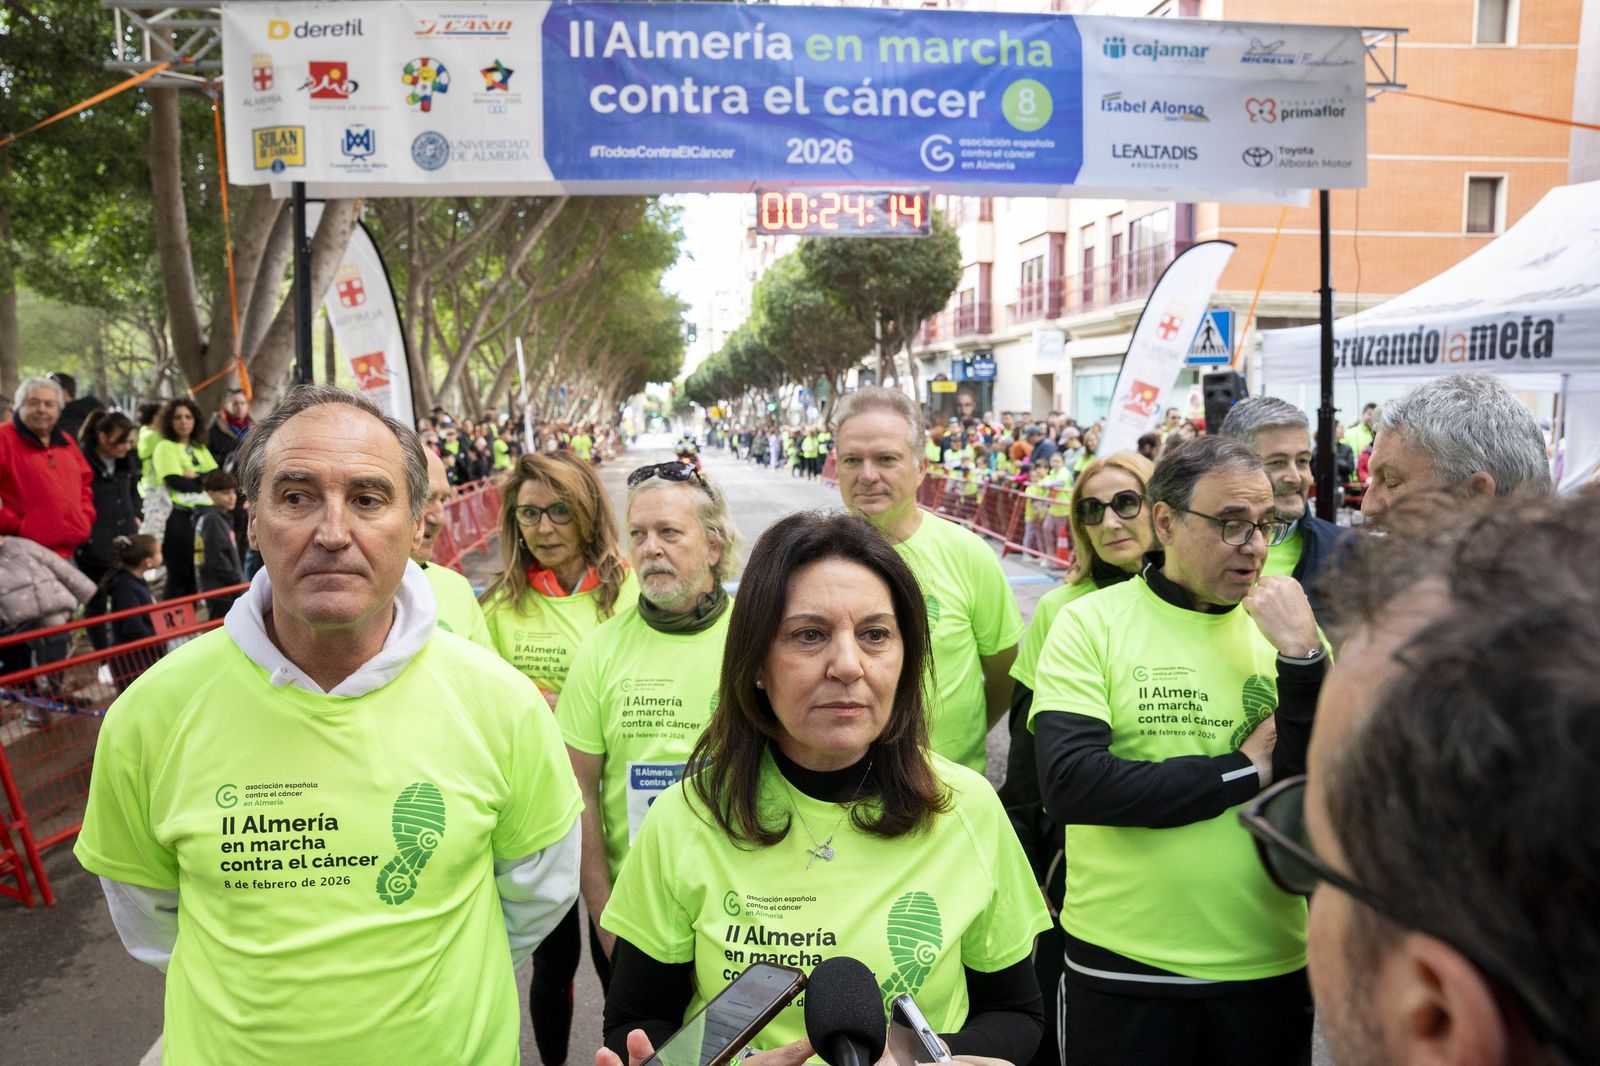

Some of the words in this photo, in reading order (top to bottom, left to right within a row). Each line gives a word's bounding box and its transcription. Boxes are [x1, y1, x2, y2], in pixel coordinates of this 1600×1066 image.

[294, 19, 364, 39] deretil
[569, 20, 595, 58] II
[602, 20, 794, 60] Almería
[806, 33, 863, 62] en
[879, 29, 1054, 67] marcha
[1132, 39, 1210, 61] cajamar
[589, 76, 749, 115] contra
[763, 76, 811, 115] el
[823, 76, 987, 118] cáncer
[1018, 87, 1037, 115] 8
[1101, 99, 1147, 114] Isabel
[1150, 101, 1205, 116] Alonso
[1281, 105, 1346, 122] primaflor
[449, 139, 530, 150] UNIVERSIDAD
[959, 137, 1012, 147] asociación
[1013, 138, 1056, 149] española
[451, 151, 466, 161] DE
[589, 144, 736, 160] #TodosContraElCáncer
[786, 138, 854, 165] 2026
[960, 149, 992, 159] contra
[993, 149, 1002, 159] el
[1003, 149, 1036, 160] cáncer
[1112, 144, 1199, 160] LEALTADIS
[1279, 146, 1314, 157] Toyota
[961, 162, 975, 170] en
[976, 160, 1016, 171] Almería
[1279, 158, 1319, 169] Alborán
[1321, 159, 1353, 169] Motor
[523, 645, 567, 655] Almería
[542, 664, 551, 672] el
[1139, 687, 1148, 699] II
[1152, 686, 1209, 702] Almería
[633, 695, 682, 707] Almería
[1138, 702, 1154, 711] en
[1158, 701, 1203, 712] marcha
[636, 708, 675, 717] marcha
[621, 719, 653, 728] contra
[655, 718, 664, 727] el
[667, 719, 701, 730] cáncer
[1138, 713, 1178, 724] contra
[1181, 713, 1192, 724] el
[1194, 716, 1234, 728] cáncer
[1159, 729, 1187, 737] febrero
[1198, 732, 1217, 740] 2026
[641, 767, 673, 777] Almería
[284, 782, 318, 790] española
[640, 778, 667, 787] contra
[254, 799, 284, 807] Almería
[222, 816, 236, 835] II
[242, 813, 339, 834] Almería
[220, 841, 245, 853] en
[250, 835, 326, 853] marcha
[220, 856, 284, 872] contra
[288, 854, 308, 869] el
[312, 853, 379, 868] cáncer
[224, 880, 231, 889] 8
[235, 879, 249, 889] de
[252, 878, 297, 890] febrero
[301, 877, 316, 888] de
[320, 875, 351, 886] 2026
[746, 894, 783, 903] asociación
[784, 895, 817, 903] española
[746, 902, 769, 911] contra
[755, 910, 784, 919] Almería
[725, 925, 741, 943] II
[744, 925, 837, 946] Almería
[724, 949, 744, 963] en
